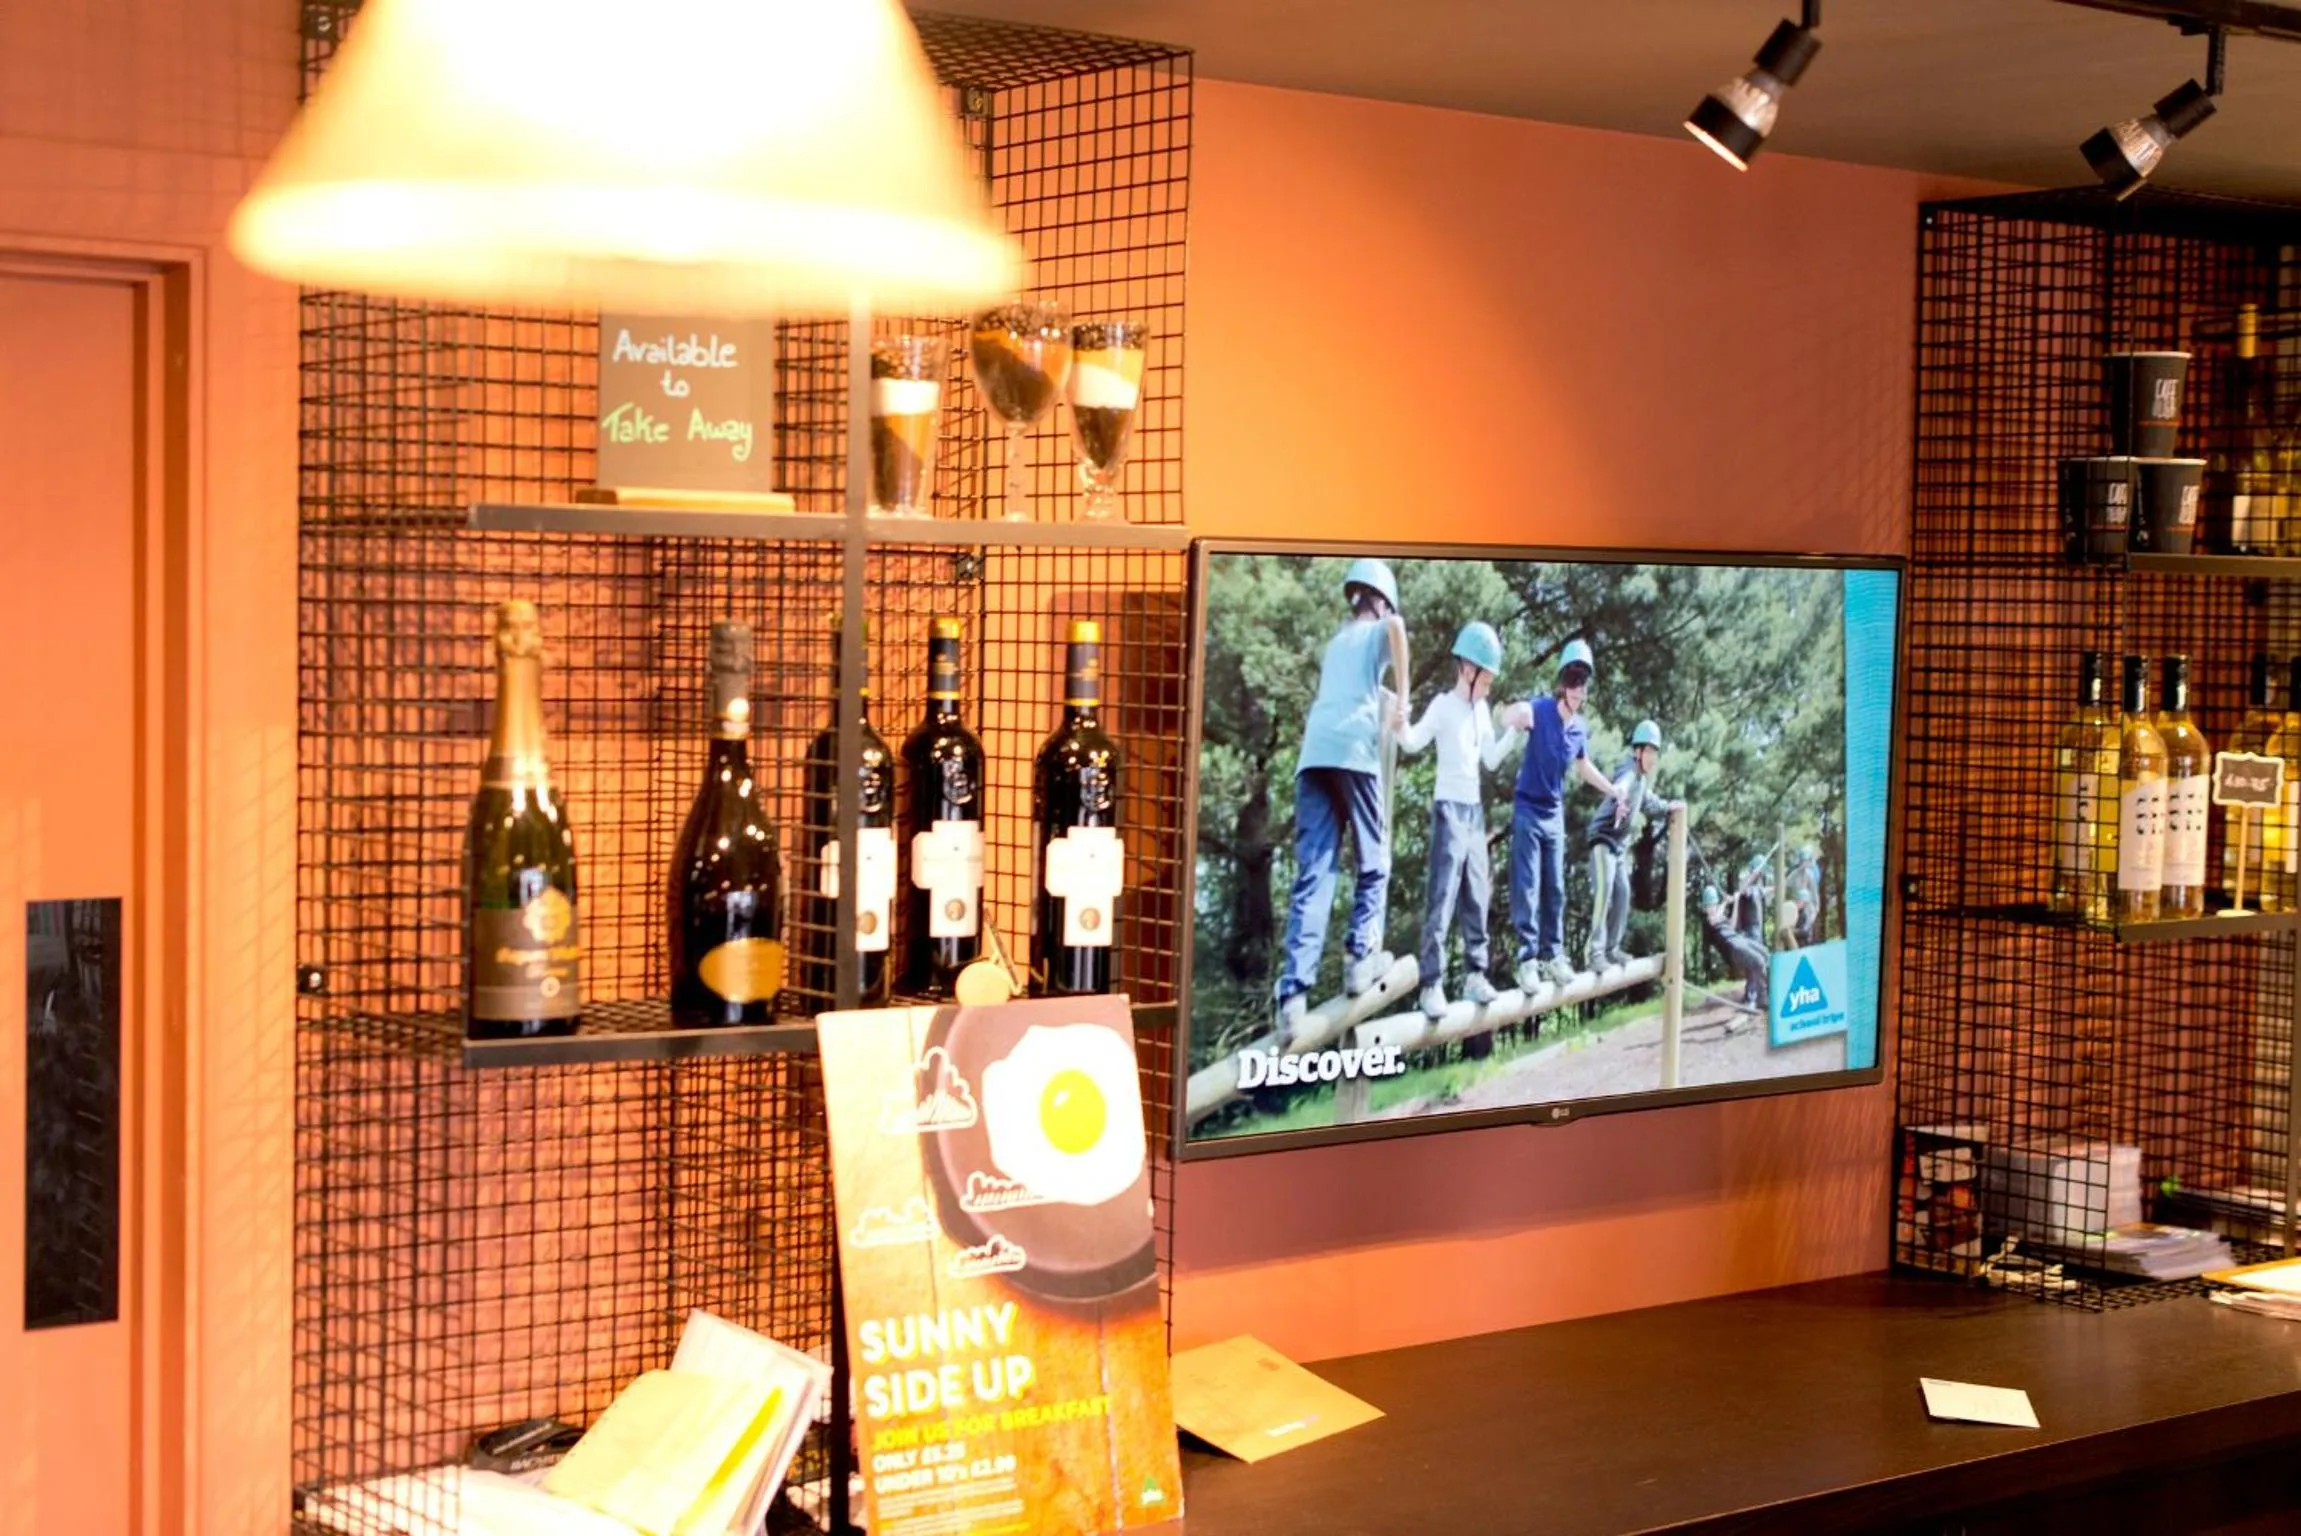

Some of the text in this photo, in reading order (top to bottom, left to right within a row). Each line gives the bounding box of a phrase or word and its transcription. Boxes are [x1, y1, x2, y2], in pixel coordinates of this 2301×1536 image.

[612, 328, 739, 368] Available
[660, 369, 690, 398] to
[602, 402, 753, 461] Take Away
[1789, 985, 1820, 1012] yha
[1236, 1045, 1405, 1089] Discover.
[859, 1302, 1017, 1364] SUNNY
[863, 1355, 1034, 1418] SIDE UP
[872, 1396, 1110, 1451] JOIN US FOR BREAKFAST
[872, 1449, 918, 1472] ONLY
[873, 1468, 934, 1494] UNDER
